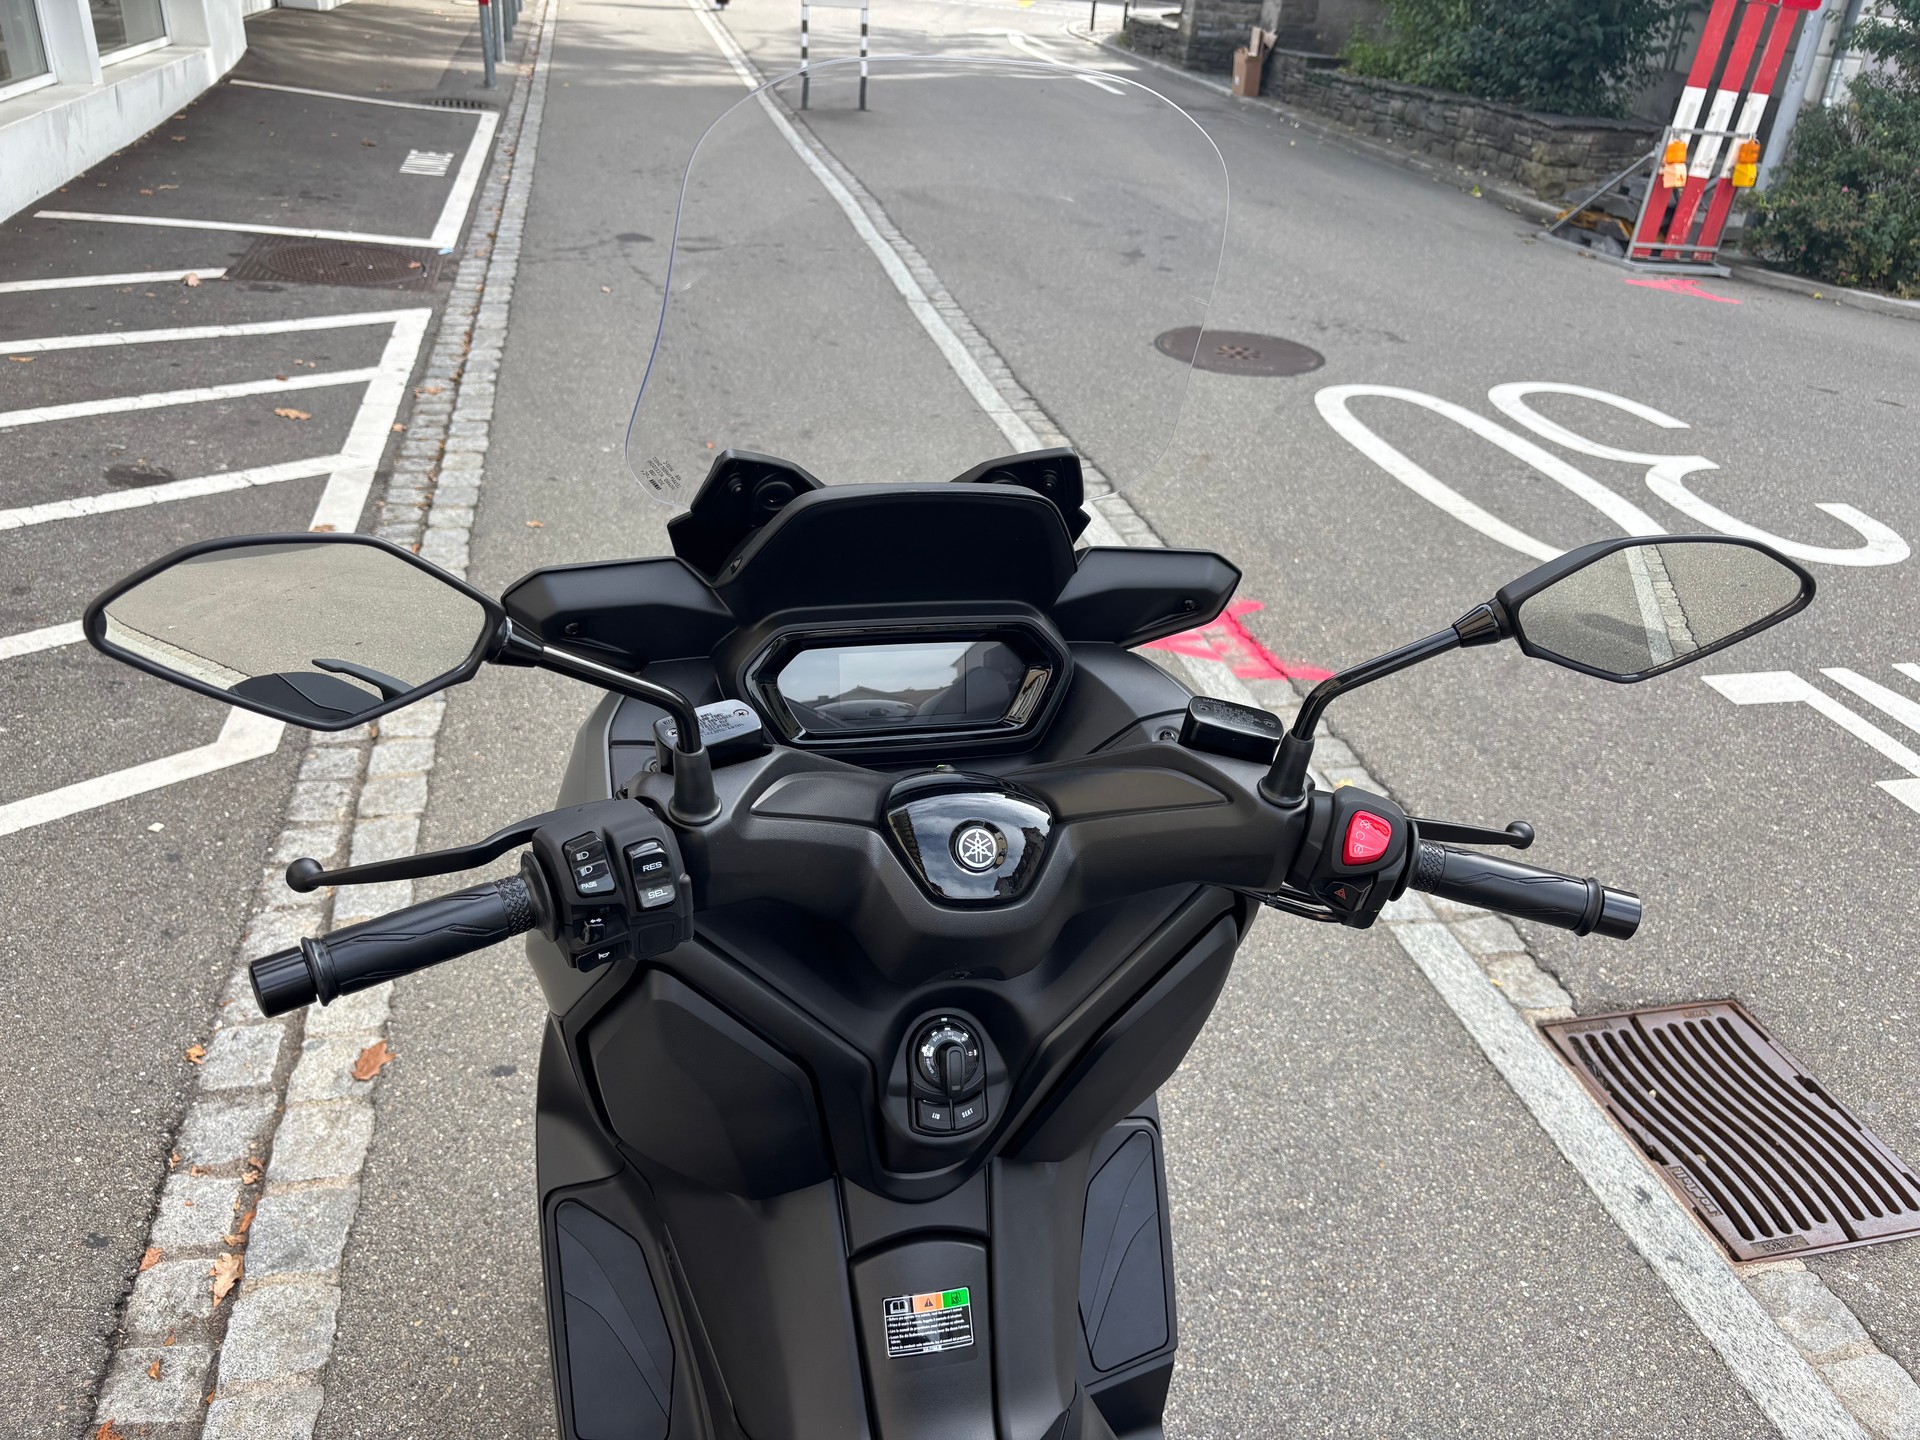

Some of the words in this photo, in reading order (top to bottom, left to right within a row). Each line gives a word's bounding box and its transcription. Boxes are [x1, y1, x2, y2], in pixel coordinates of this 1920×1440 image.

[1314, 382, 1910, 567] 30
[642, 861, 663, 872] RES
[581, 881, 597, 889] PASS
[648, 889, 668, 899] SEL
[961, 1107, 974, 1118] SEAT
